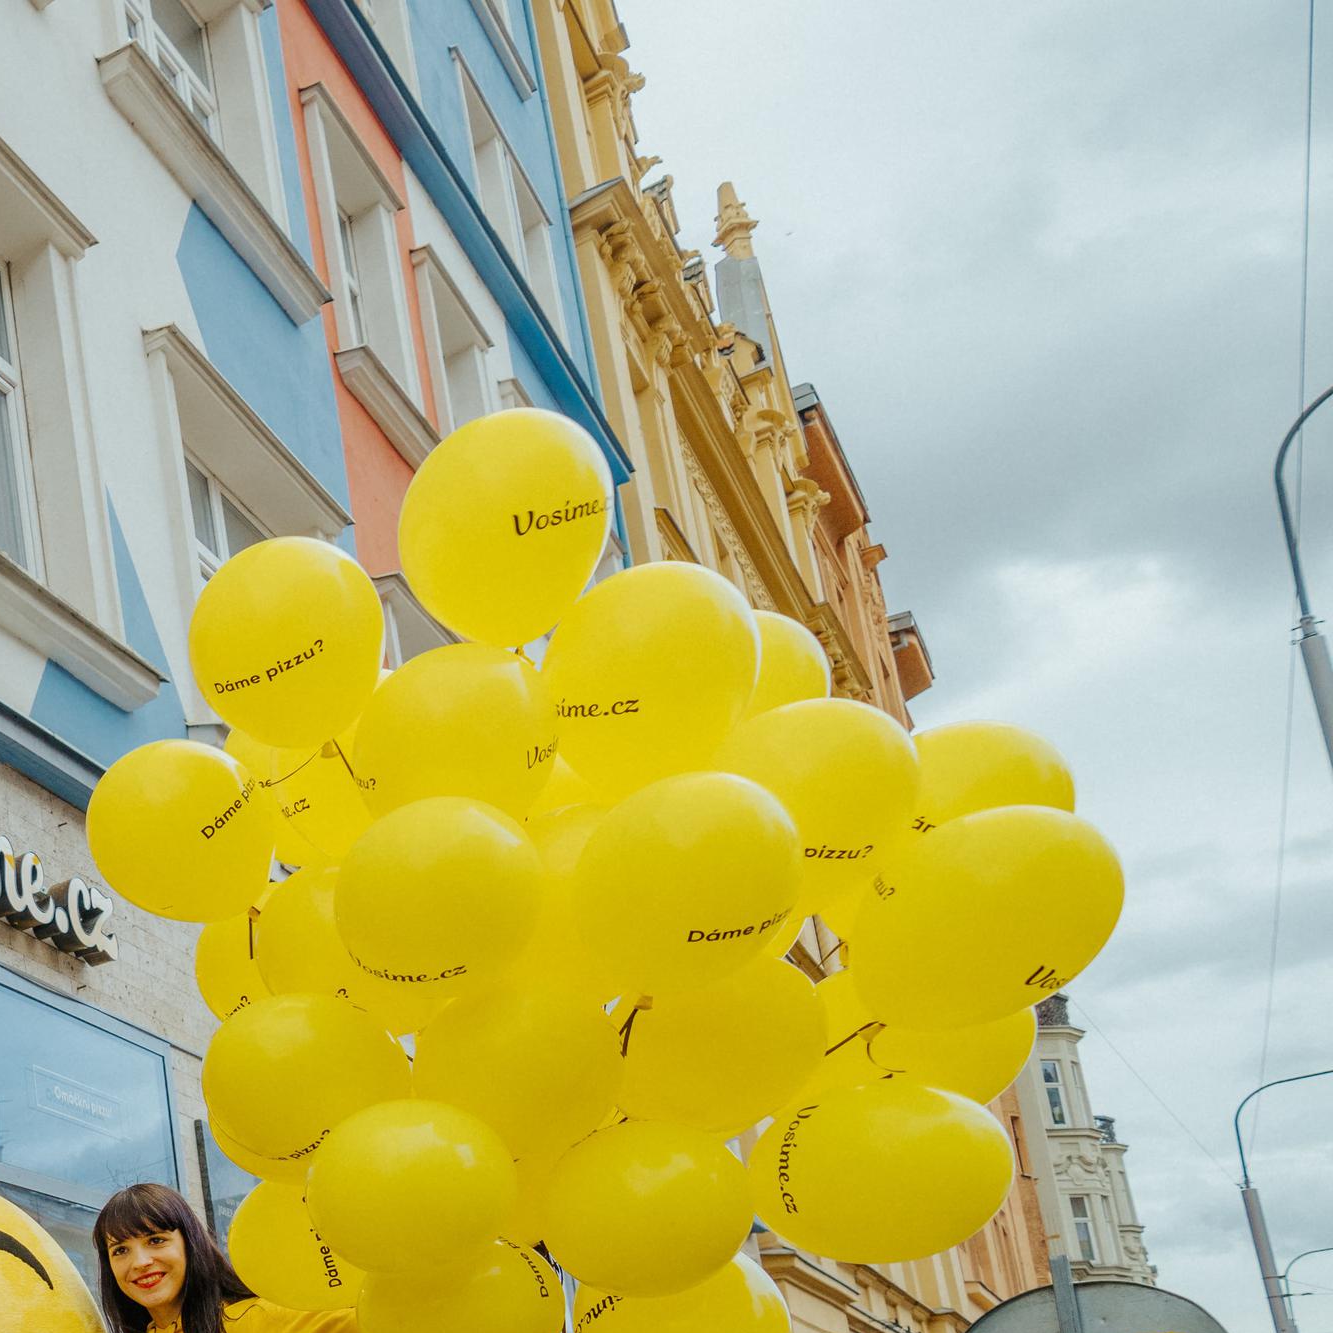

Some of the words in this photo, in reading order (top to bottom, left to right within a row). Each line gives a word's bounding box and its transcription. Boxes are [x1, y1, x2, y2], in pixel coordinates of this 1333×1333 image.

[214, 671, 262, 695] Dáme
[265, 638, 325, 682] pizzu?
[555, 697, 640, 718] íme.cz
[201, 796, 243, 840] Dáme
[686, 922, 753, 944] Dáme
[777, 1104, 820, 1216] Vosíme.cz
[317, 1244, 342, 1288] Dáme
[520, 1251, 550, 1298] Dáme
